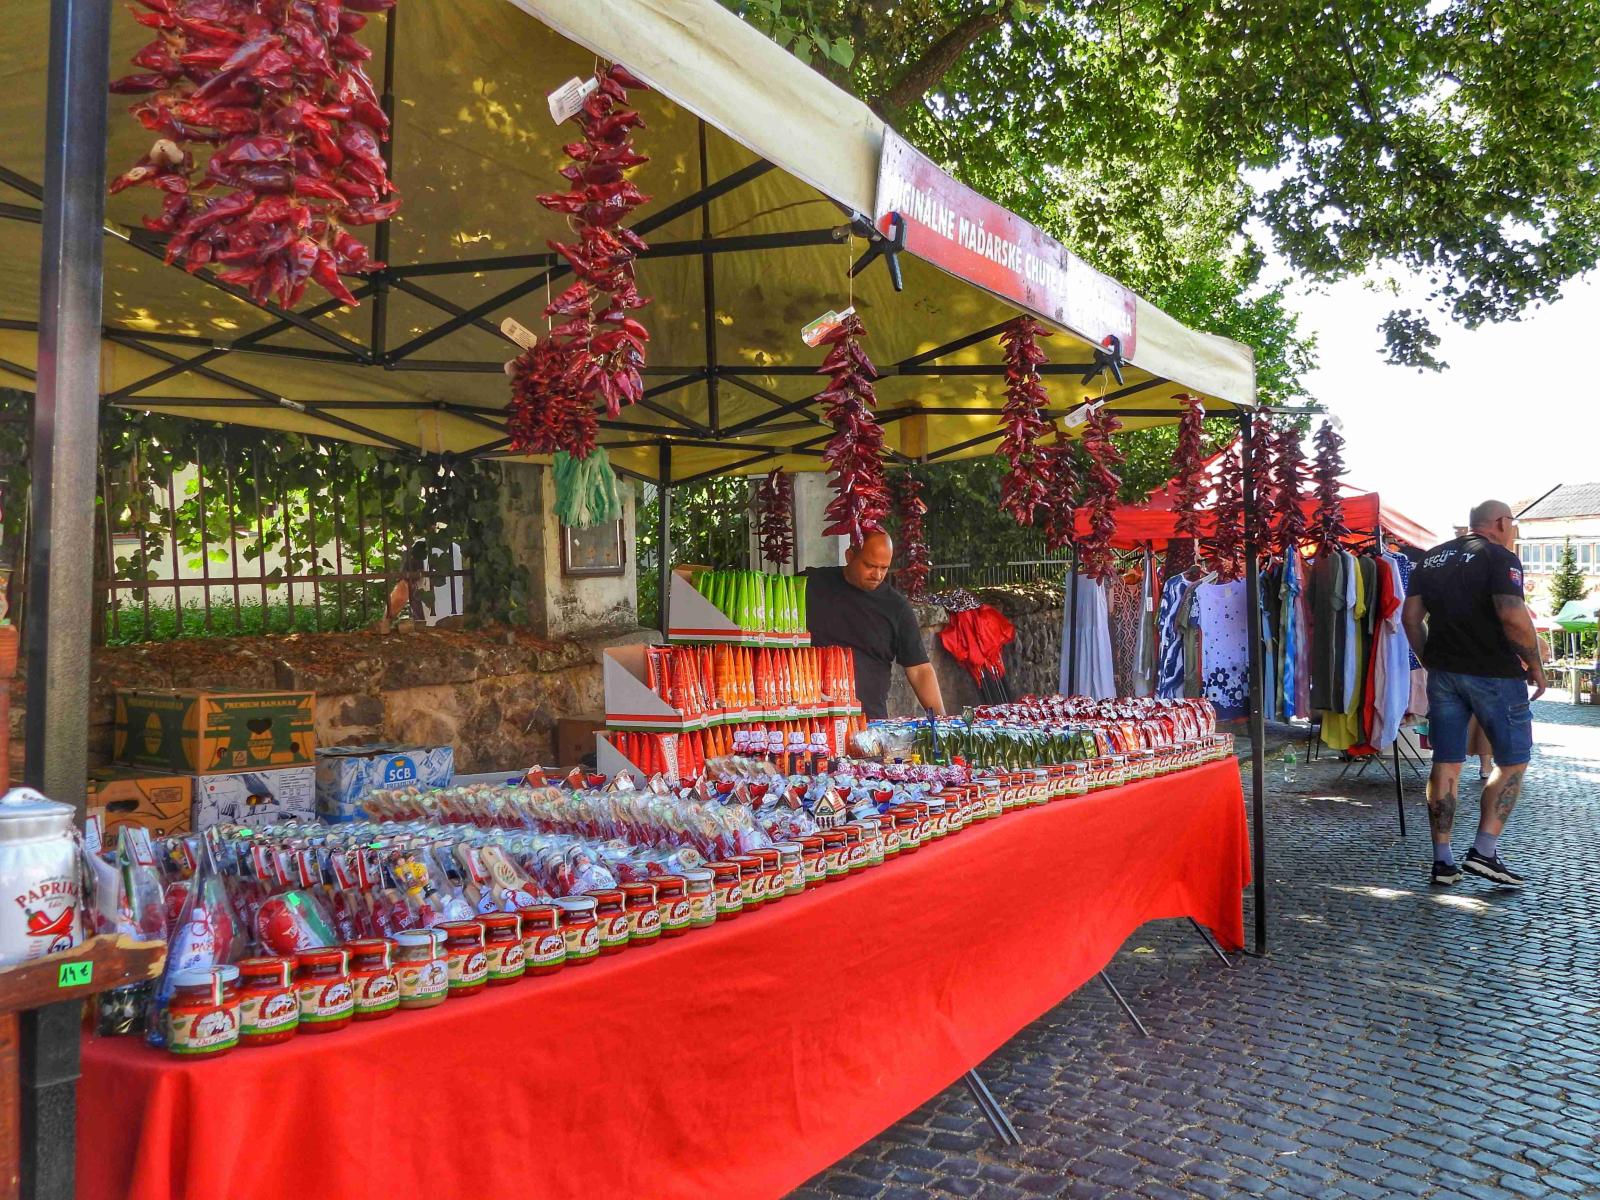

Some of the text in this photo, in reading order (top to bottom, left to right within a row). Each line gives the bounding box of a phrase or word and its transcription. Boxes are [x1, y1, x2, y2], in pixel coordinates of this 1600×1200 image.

[895, 181, 955, 240] IGINÁLNE
[959, 217, 1022, 273] MAĎARSKÉ
[389, 767, 411, 781] SCB
[80, 964, 89, 976] €
